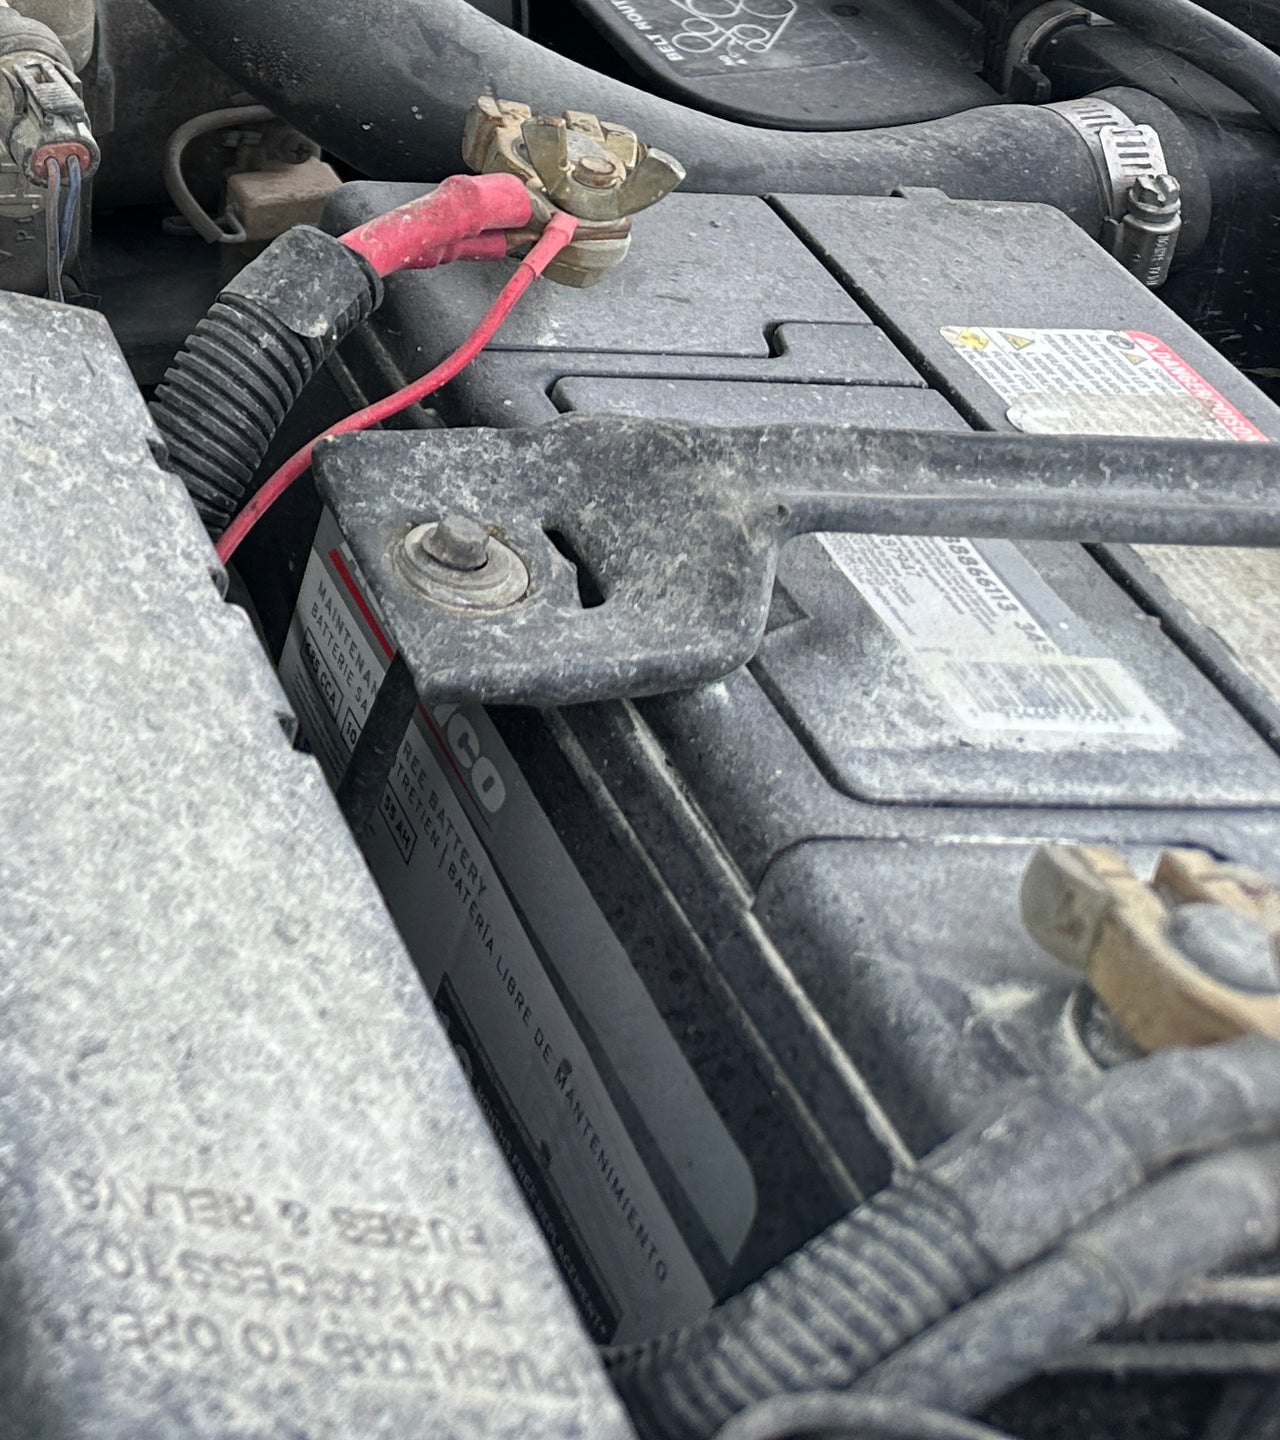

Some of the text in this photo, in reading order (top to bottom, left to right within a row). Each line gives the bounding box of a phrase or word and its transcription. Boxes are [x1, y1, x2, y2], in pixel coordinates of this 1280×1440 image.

[645, 33, 685, 62] BELT
[319, 670, 339, 709] CCA
[428, 795, 488, 898] BATTERY
[309, 604, 356, 688] BATTERIE
[496, 953, 533, 1028] LIBRE
[532, 1026, 555, 1065] DE
[553, 1066, 670, 1283] MANTENIMIENTO
